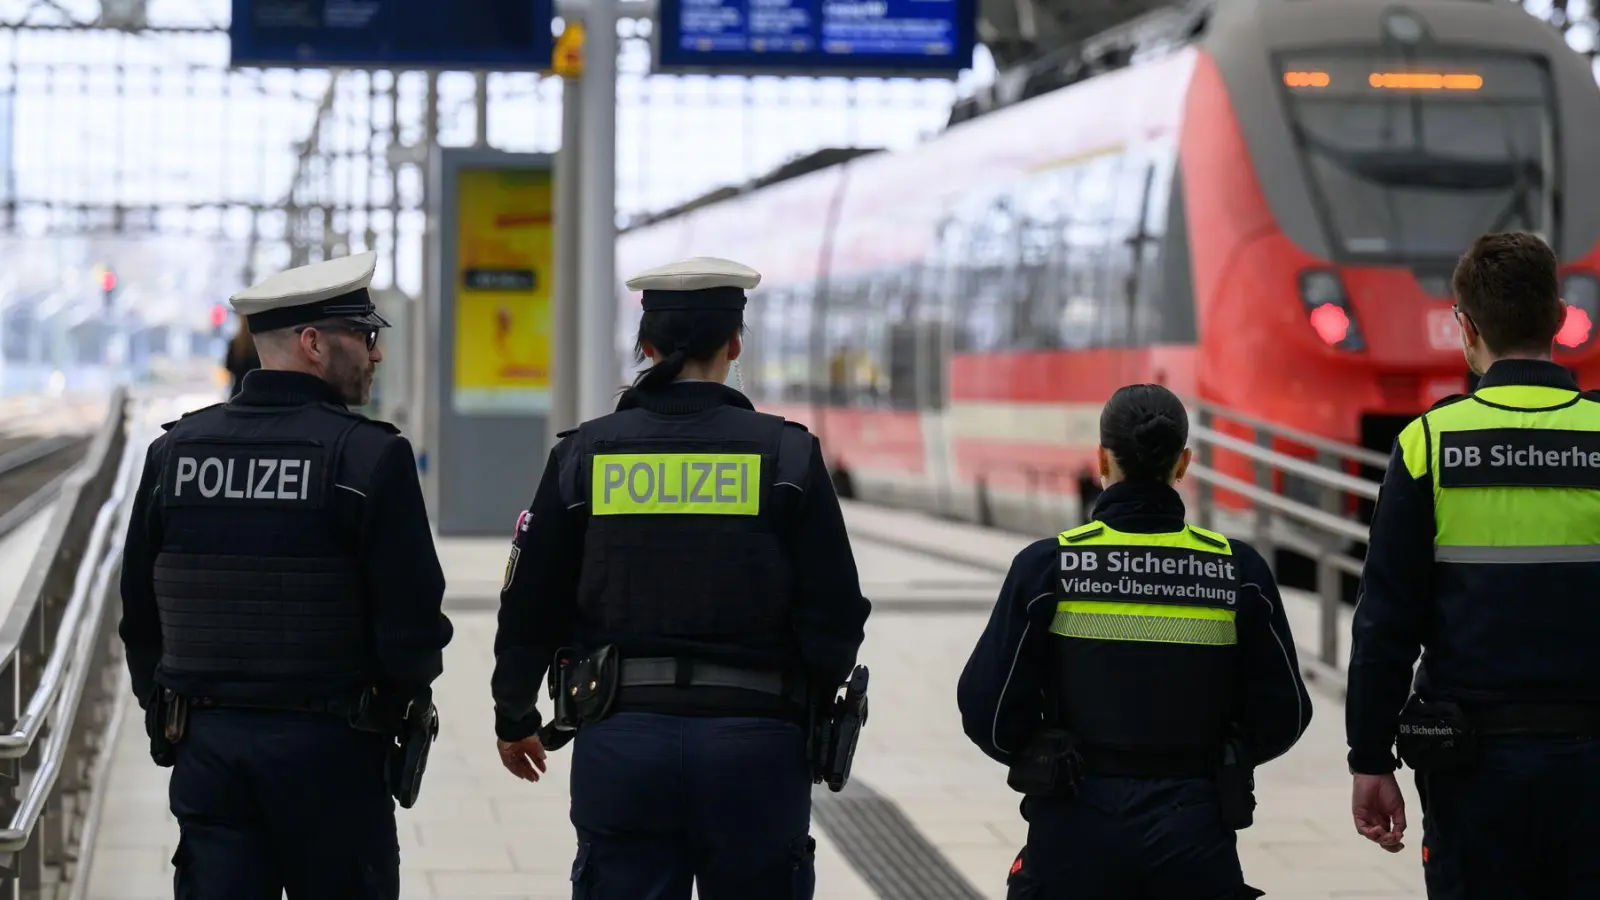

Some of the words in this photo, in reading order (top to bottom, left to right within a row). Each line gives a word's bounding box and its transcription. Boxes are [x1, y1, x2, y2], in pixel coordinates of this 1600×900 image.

[1444, 446, 1482, 468] DB
[1490, 444, 1600, 468] Sicherhe
[174, 456, 311, 500] POLIZEI
[604, 462, 748, 504] POLIZEI
[1060, 551, 1098, 571] DB
[1107, 551, 1236, 580] Sicherheit
[1061, 576, 1236, 605] Video-Überwachung
[1400, 724, 1411, 734] DB
[1411, 725, 1454, 735] Sicherheit
